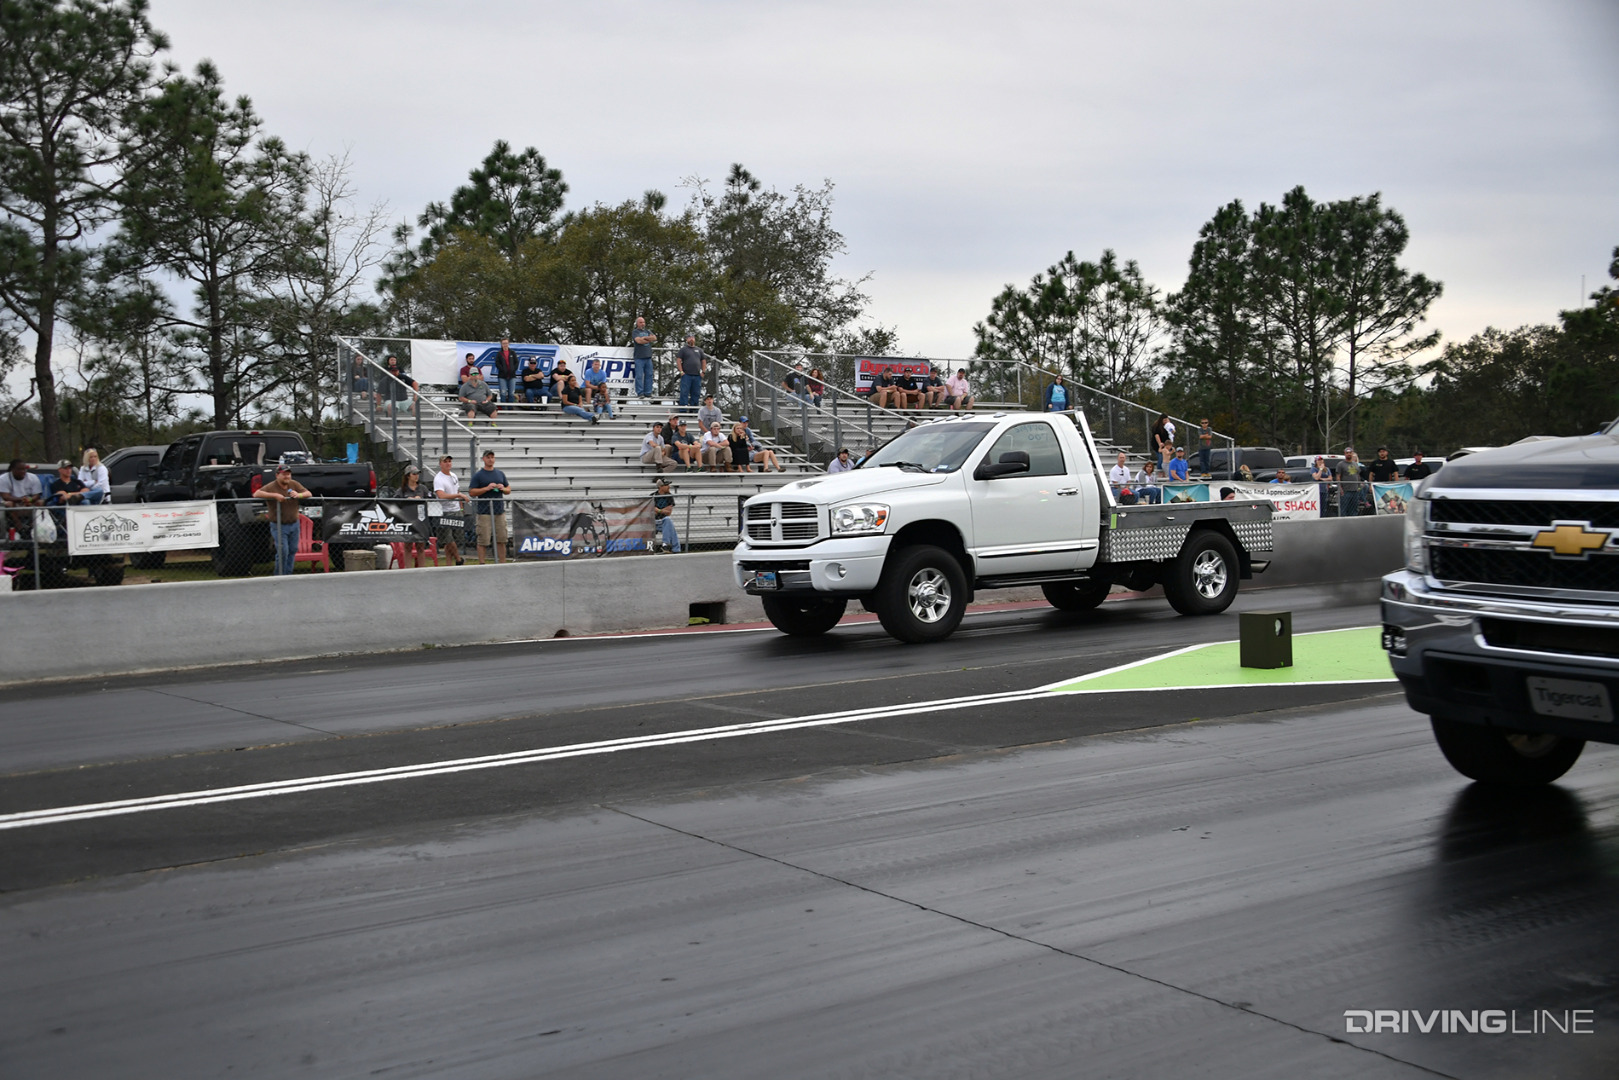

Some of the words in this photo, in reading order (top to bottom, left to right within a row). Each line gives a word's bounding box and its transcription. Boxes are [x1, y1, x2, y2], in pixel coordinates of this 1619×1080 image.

[575, 351, 598, 363] Team
[860, 360, 929, 375] Dynatech
[1266, 488, 1300, 496] Appreciation
[1284, 500, 1317, 511] SHACK
[84, 522, 139, 533] Asheville
[340, 522, 413, 531] SUNCOAST
[520, 537, 572, 554] AirDog
[606, 537, 646, 552] DIESEL
[1534, 686, 1604, 708] Tigercat
